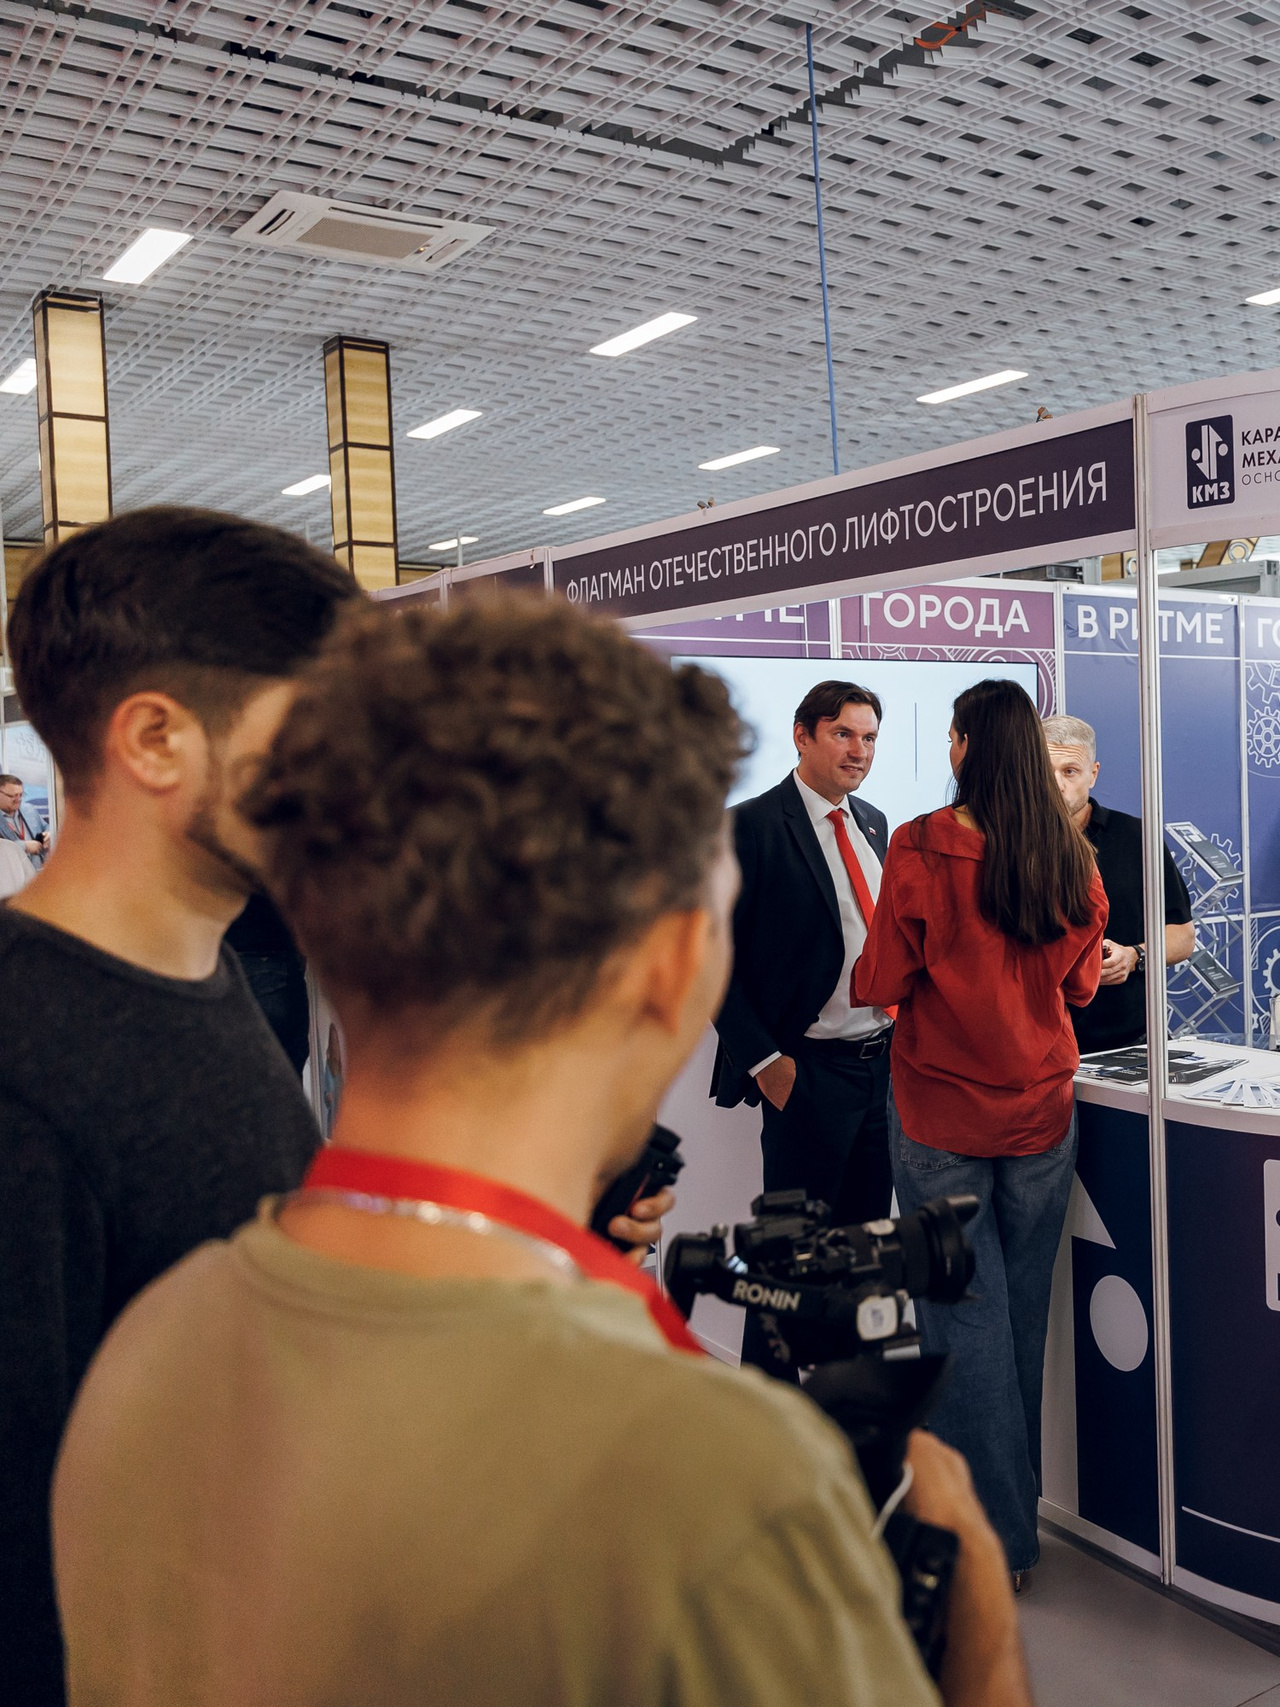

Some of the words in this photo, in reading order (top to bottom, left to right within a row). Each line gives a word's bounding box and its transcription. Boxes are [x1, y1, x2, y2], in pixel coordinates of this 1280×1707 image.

[1192, 482, 1231, 504] КМЗ
[567, 560, 646, 604] ФЛАГМАН
[649, 522, 836, 591] ОТЕЧЕСТВЕННОГО
[842, 461, 1108, 554] ЛИФТОСТРОЕНИЯ
[863, 592, 1030, 638] ГОРОДА
[1077, 604, 1098, 638] В
[732, 1279, 801, 1312] RONIN
